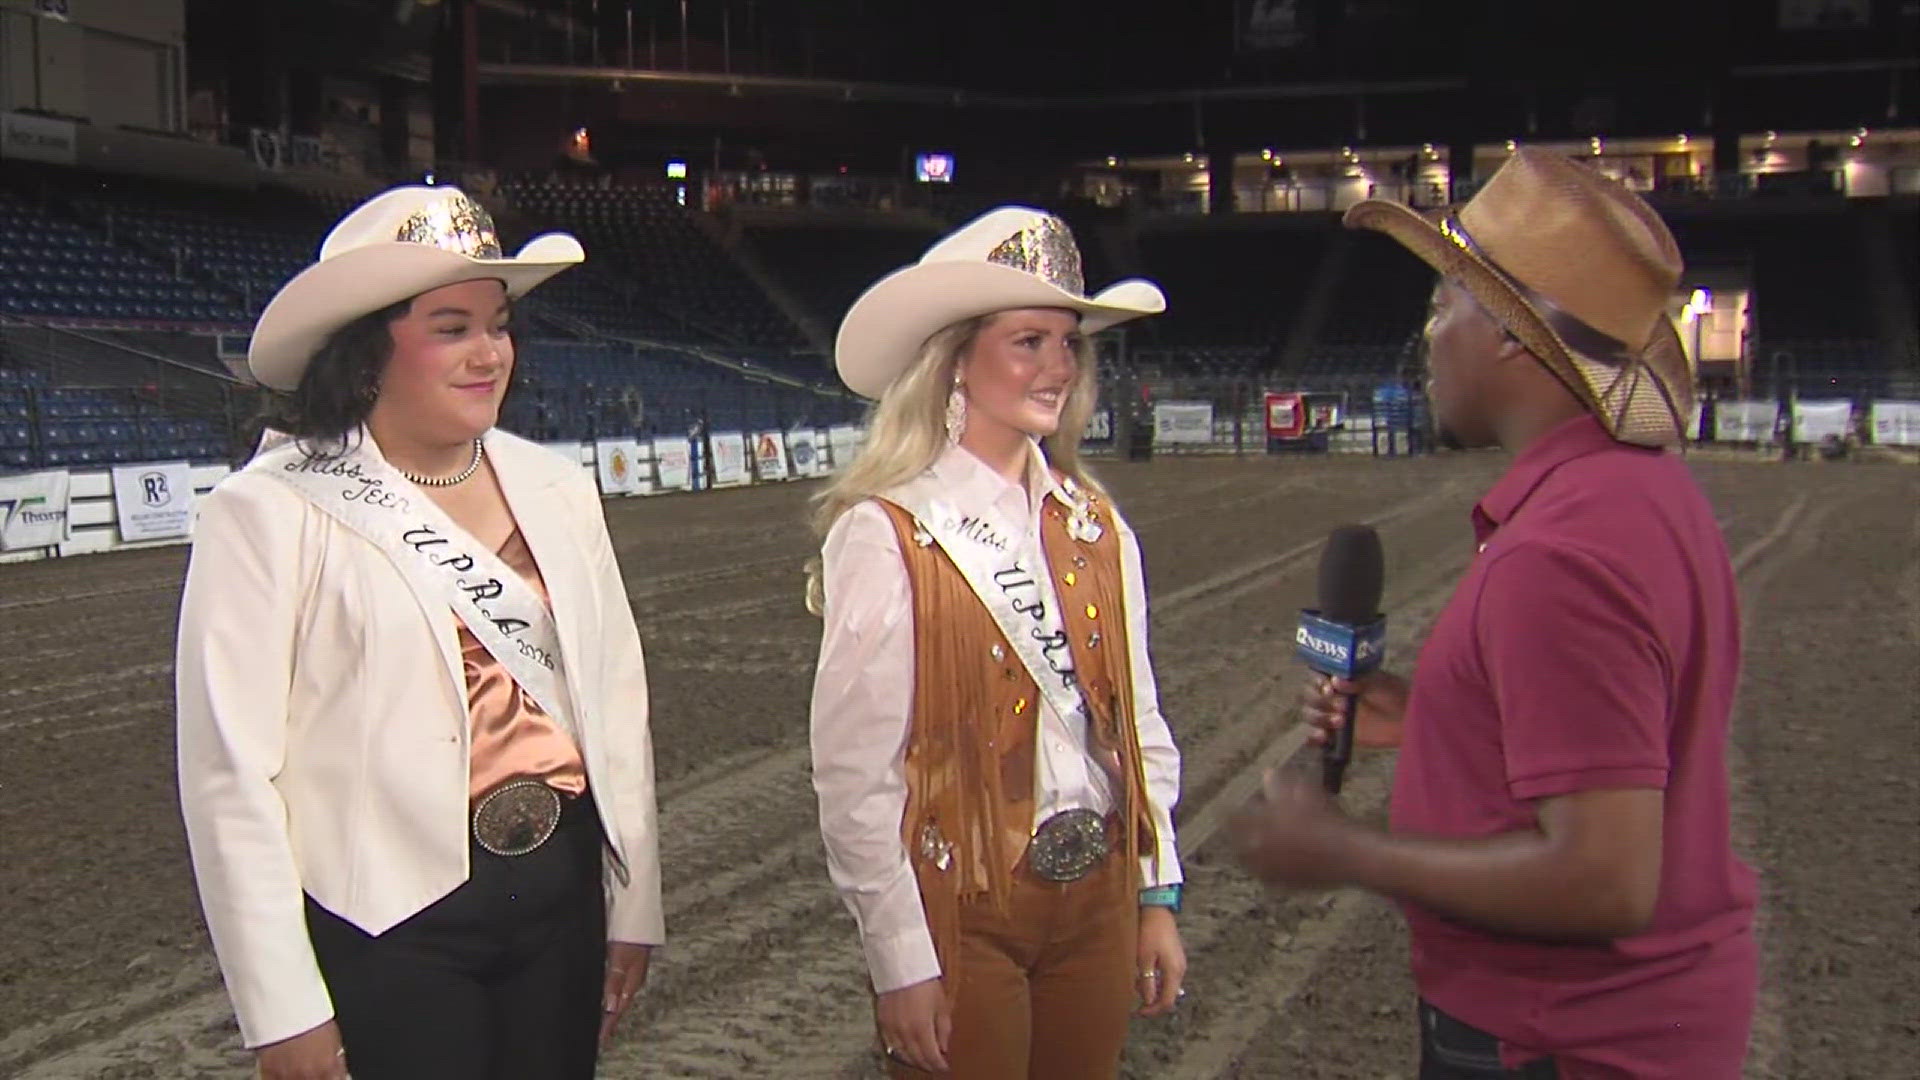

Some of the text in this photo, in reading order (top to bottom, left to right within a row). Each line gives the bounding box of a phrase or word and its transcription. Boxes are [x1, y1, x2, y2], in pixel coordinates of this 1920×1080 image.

[284, 452, 363, 478] Miss
[402, 524, 532, 638] UPRA
[516, 639, 555, 671] 2026
[944, 517, 1008, 551] Miss
